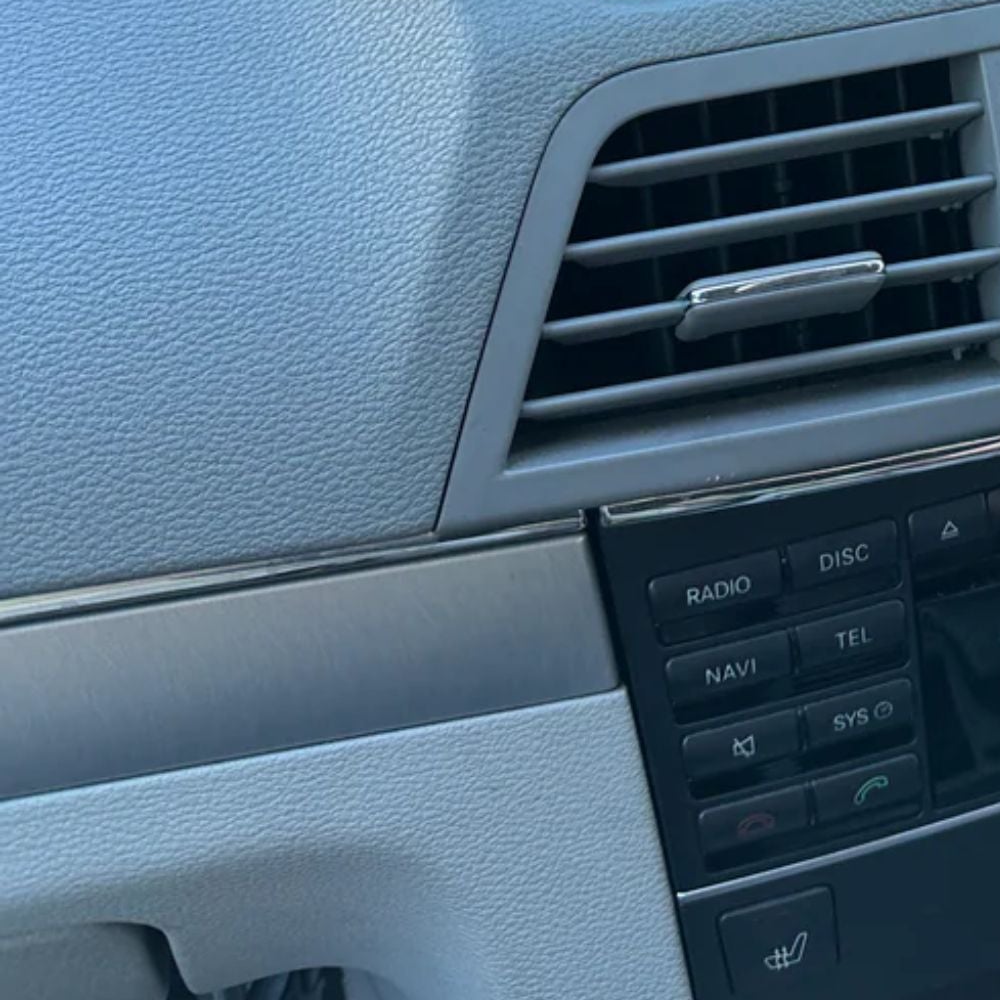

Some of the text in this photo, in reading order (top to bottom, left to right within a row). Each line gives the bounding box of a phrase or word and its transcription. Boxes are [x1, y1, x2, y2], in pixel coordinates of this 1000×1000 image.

[818, 543, 870, 572] DISC
[686, 575, 752, 607] RADIO
[834, 625, 873, 650] TEL
[704, 657, 757, 686] NAVI
[833, 707, 869, 733] SYS
